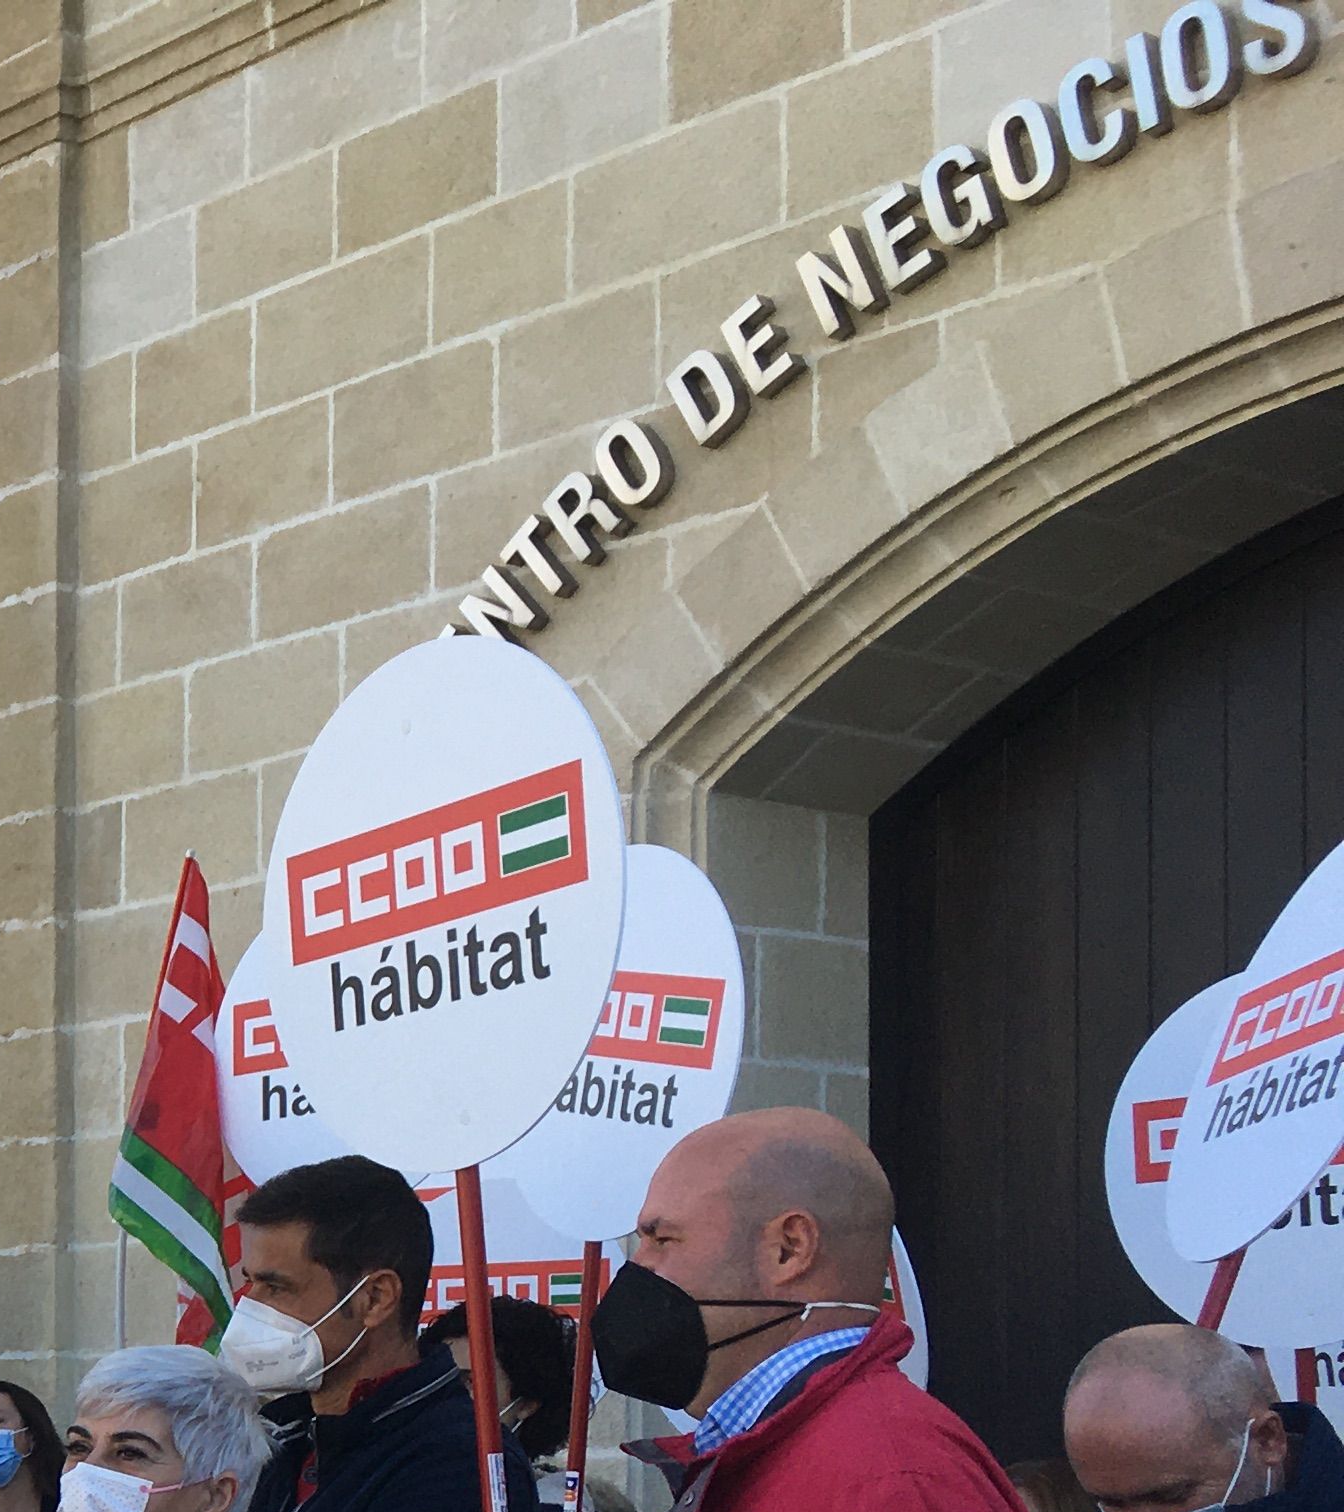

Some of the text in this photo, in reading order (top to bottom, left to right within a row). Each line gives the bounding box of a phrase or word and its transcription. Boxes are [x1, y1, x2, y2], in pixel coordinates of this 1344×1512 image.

[438, 0, 1315, 640] NTRO DE NEGOCIOS
[302, 821, 485, 938] CCOO
[331, 906, 551, 1032] hábitat
[556, 1061, 678, 1129] bitat
